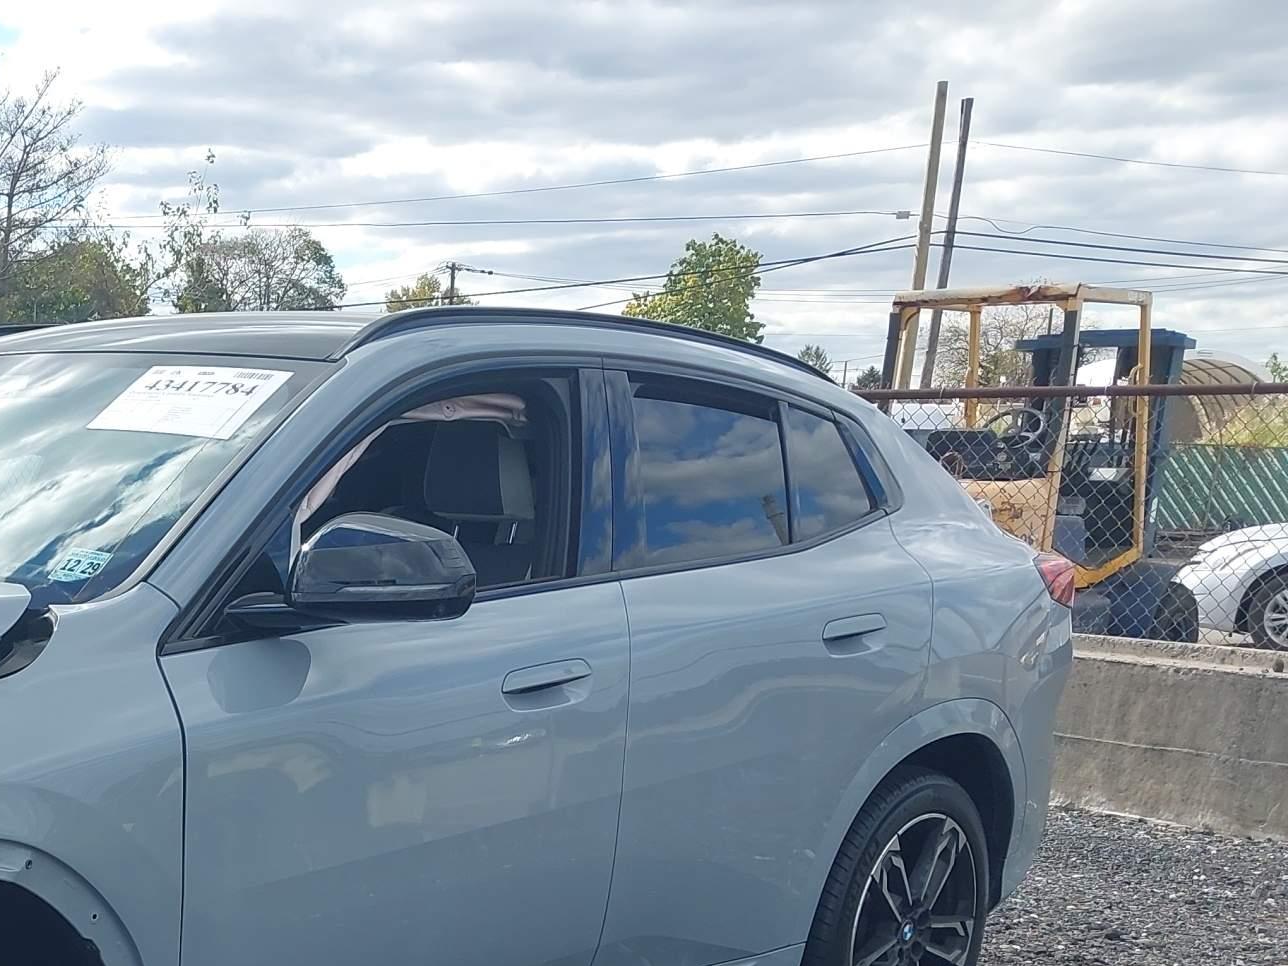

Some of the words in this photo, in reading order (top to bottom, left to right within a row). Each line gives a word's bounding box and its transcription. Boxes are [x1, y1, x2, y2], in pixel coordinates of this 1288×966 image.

[144, 379, 260, 397] 43417784
[59, 558, 82, 573] 12
[79, 560, 101, 576] 29
